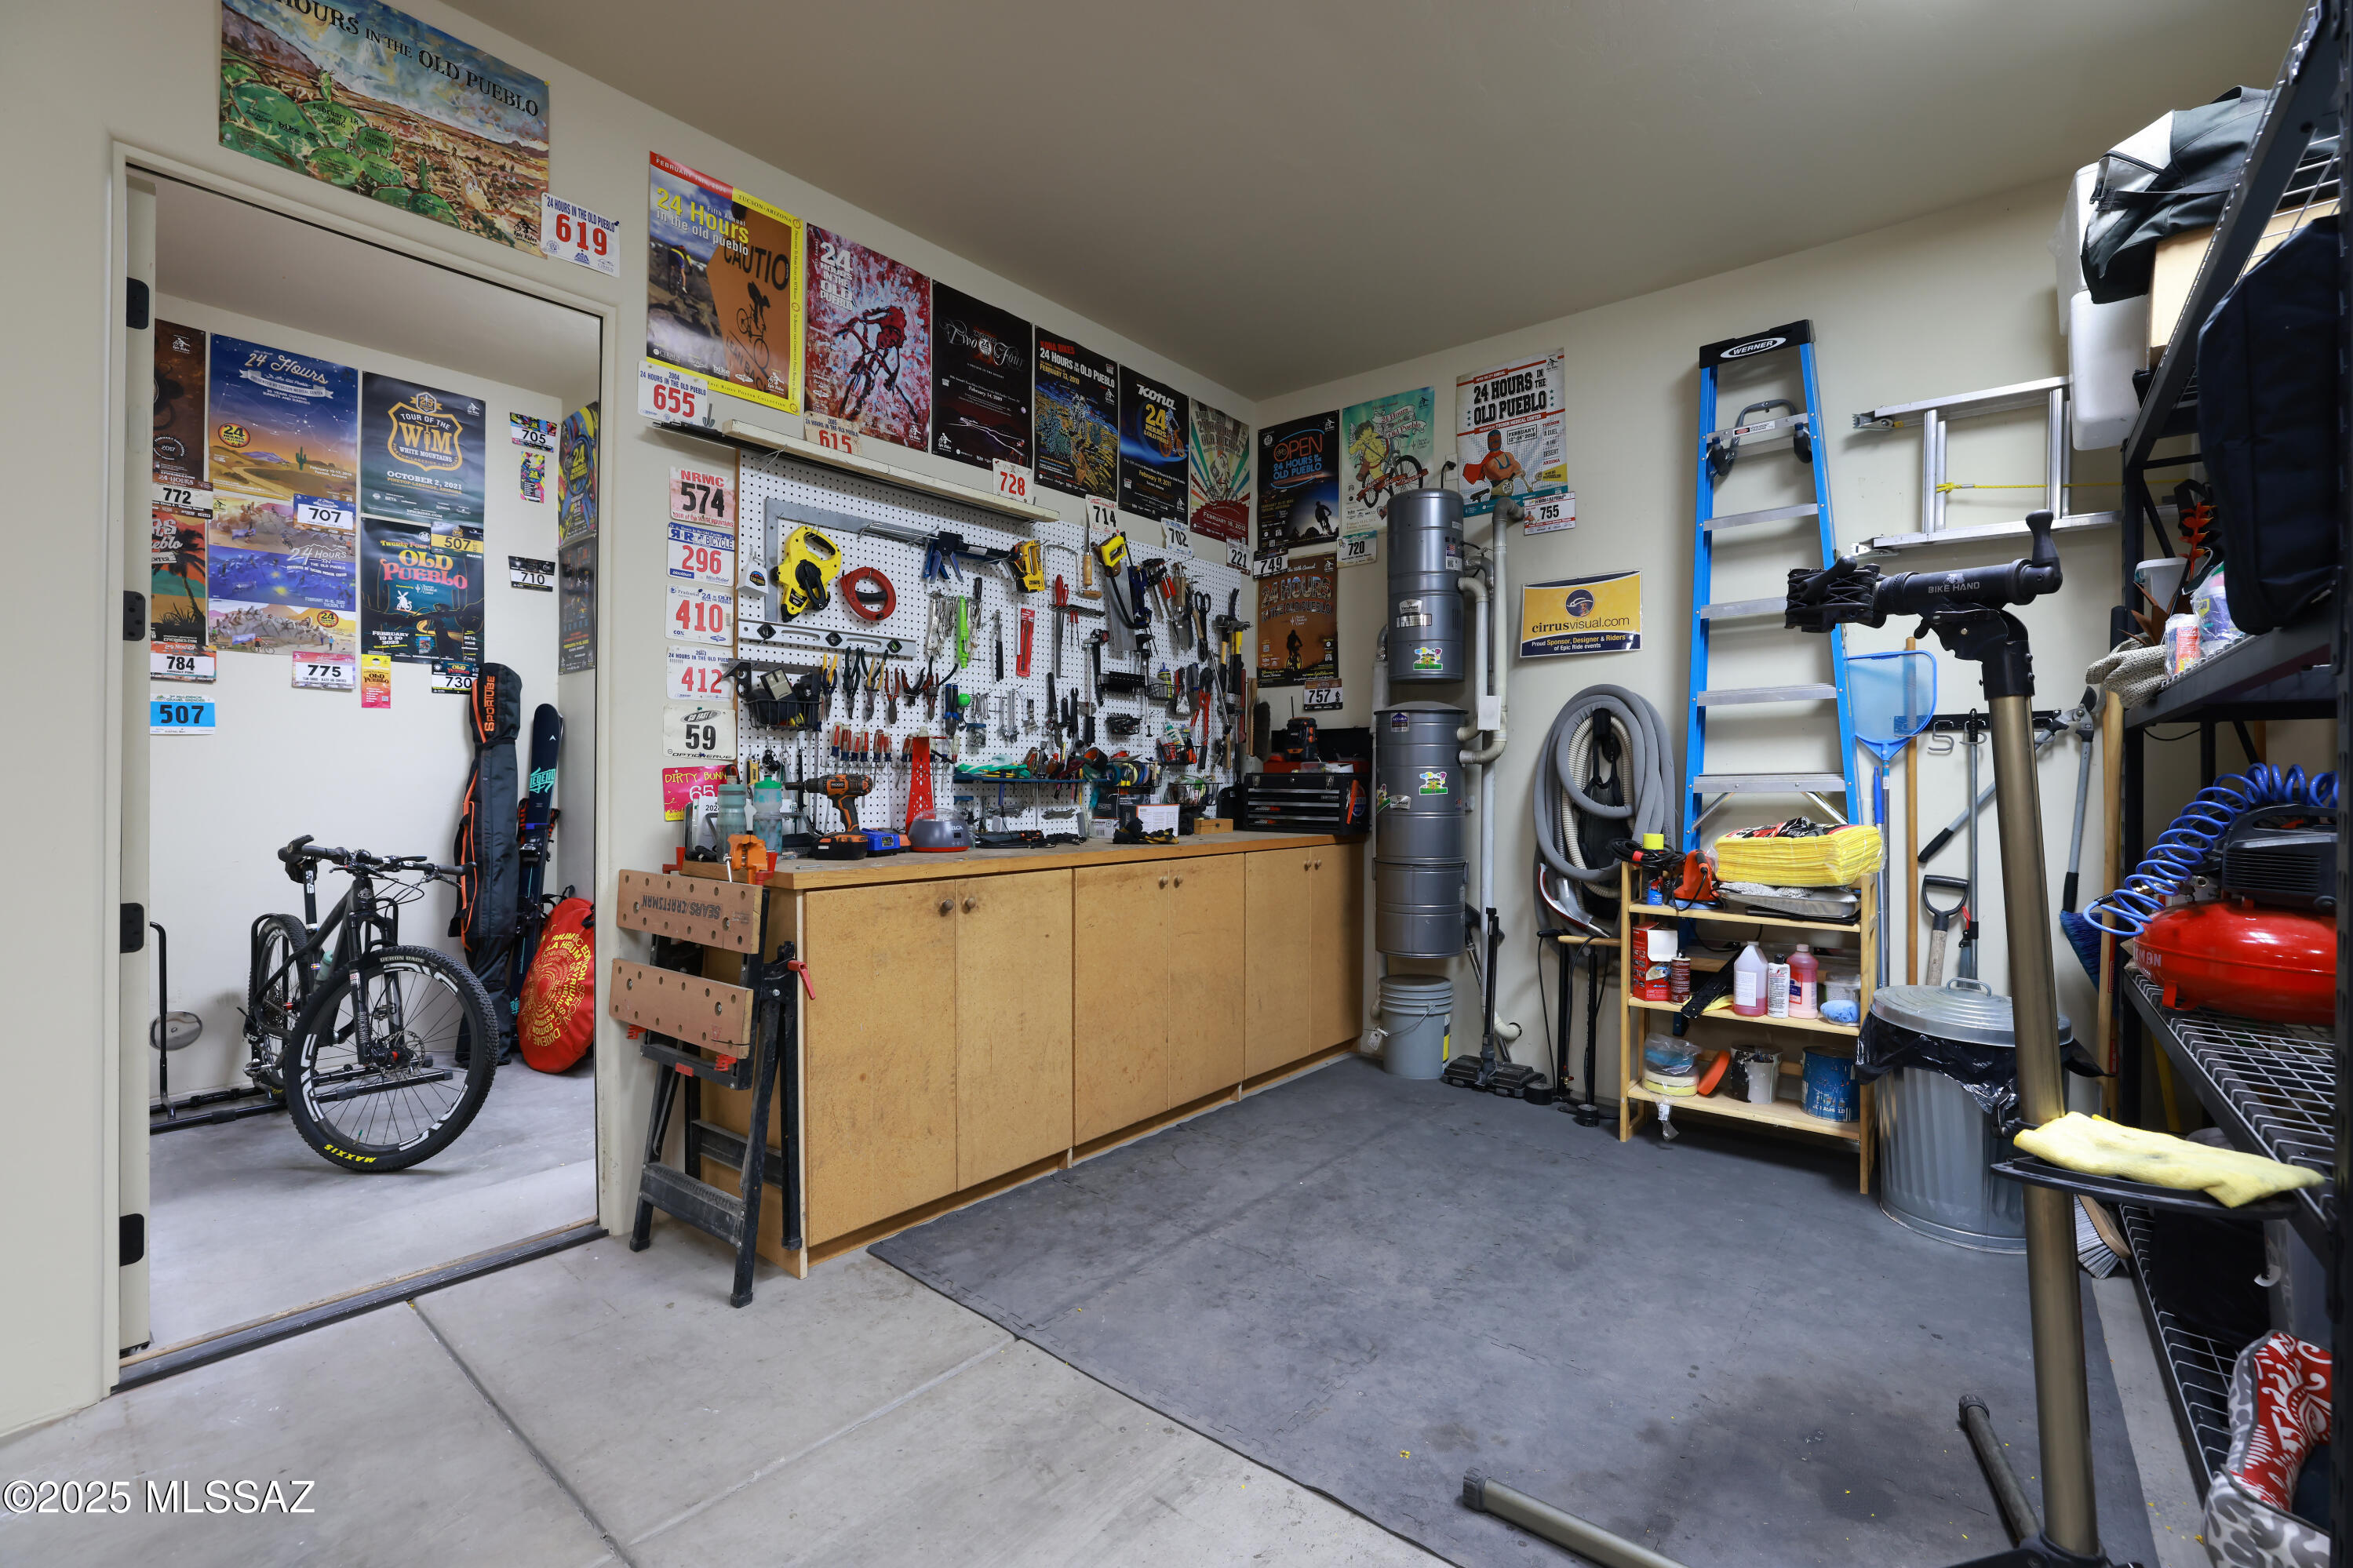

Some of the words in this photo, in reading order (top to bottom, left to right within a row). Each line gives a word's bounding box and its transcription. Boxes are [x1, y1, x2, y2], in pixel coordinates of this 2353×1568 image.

[365, 28, 381, 44] IN
[384, 37, 412, 58] THE
[417, 49, 460, 80] OLD
[465, 69, 539, 116] PUEBLO
[656, 158, 692, 178] FEBRUARY
[547, 196, 554, 208] 24
[555, 199, 570, 215] HOURS
[571, 206, 577, 216] IN
[578, 208, 587, 220] THE
[588, 213, 596, 224] OLD
[597, 216, 614, 232] PUEBLO
[657, 187, 683, 216] 24
[690, 201, 749, 244] Hours
[707, 206, 722, 216] Fifth
[724, 213, 745, 226] Annual
[738, 195, 763, 209] TUCSON
[767, 206, 792, 224] ARIZONA
[556, 213, 606, 256] 619
[657, 209, 668, 220] in
[670, 213, 689, 231] the
[692, 225, 708, 240] old
[712, 234, 749, 256] pueblo
[820, 242, 854, 273] 24
[824, 270, 832, 282] IN
[833, 275, 848, 287] THE
[821, 280, 852, 301] OLD
[821, 289, 852, 311] PUEBLO
[727, 337, 743, 367] LEAN
[1732, 340, 1773, 355] WERNER
[245, 353, 268, 367] 24
[271, 355, 329, 384] Hours
[668, 371, 680, 380] 2004
[1040, 347, 1050, 360] 24
[1051, 351, 1073, 369] HOURS
[1080, 364, 1092, 378] OLD
[1093, 369, 1115, 388] PUEBLO
[1040, 363, 1062, 377] FEBRUARY
[647, 373, 663, 384] HOURS
[664, 377, 669, 385] IN
[680, 381, 689, 391] OLD
[690, 385, 706, 396] PUEBLO
[1473, 385, 1488, 405] 24
[1491, 371, 1533, 400] HOURS
[1536, 369, 1544, 377] IN
[1534, 378, 1546, 388] THE
[654, 384, 694, 418] 655
[1473, 402, 1496, 426] OLD
[1499, 390, 1547, 420] PUEBLO
[1146, 403, 1167, 431] 24
[1390, 407, 1408, 421] Hours
[224, 426, 245, 438] 24
[436, 419, 451, 430] THE
[1145, 424, 1167, 438] HOURS
[1388, 428, 1399, 438] Old
[1400, 422, 1422, 435] Pueblo
[1508, 427, 1536, 438] FEBRUARY
[522, 429, 546, 444] 705
[818, 430, 852, 454] 615
[399, 446, 418, 456] WHITE
[420, 450, 453, 463] MOUNTAINS
[573, 444, 585, 467] 24
[1273, 434, 1323, 462] OPEN
[1273, 471, 1288, 480] OLD
[1291, 463, 1322, 477] PUEBLO
[1286, 457, 1312, 469] HOURS
[387, 471, 432, 485] OCTOBER
[444, 481, 463, 490] 2021
[680, 469, 724, 488] NRMC
[1000, 471, 1025, 497] 728
[163, 487, 191, 504] 772
[681, 481, 725, 518] 574
[308, 507, 341, 523] 707
[1093, 505, 1116, 527] 714
[1203, 511, 1226, 525] FEBRUARY
[1540, 504, 1560, 520] 755
[444, 537, 472, 551] 507
[706, 534, 733, 549] BICYCLE
[1168, 527, 1189, 548] 702
[286, 547, 312, 566] 24
[315, 549, 347, 558] HOURS
[1348, 541, 1365, 555] 720
[399, 549, 453, 571] OLD
[682, 544, 722, 575] 296
[1231, 549, 1247, 569] 221
[1260, 556, 1282, 574] 749
[380, 558, 468, 589] PUEBLO
[520, 573, 545, 585] 710
[1262, 580, 1278, 608] 24
[1280, 576, 1331, 601] HOURS
[1928, 584, 1951, 594] BIKE
[1952, 581, 1980, 591] HAND
[676, 599, 723, 633] 410
[1286, 602, 1300, 613] OLD
[1302, 600, 1331, 614] PUEBLO
[1532, 617, 1630, 633] cirrusvisual.com
[166, 656, 195, 671] 784
[308, 664, 341, 677] 775
[446, 676, 472, 688] 730
[681, 666, 722, 694] 412
[483, 675, 496, 733] SPORTUBE
[1309, 689, 1331, 703] 757
[159, 704, 204, 724] 507
[685, 724, 716, 751] 59
[529, 767, 556, 793] LEGEND
[665, 773, 698, 784] DIRTY
[323, 1143, 377, 1165] MAXXIS
